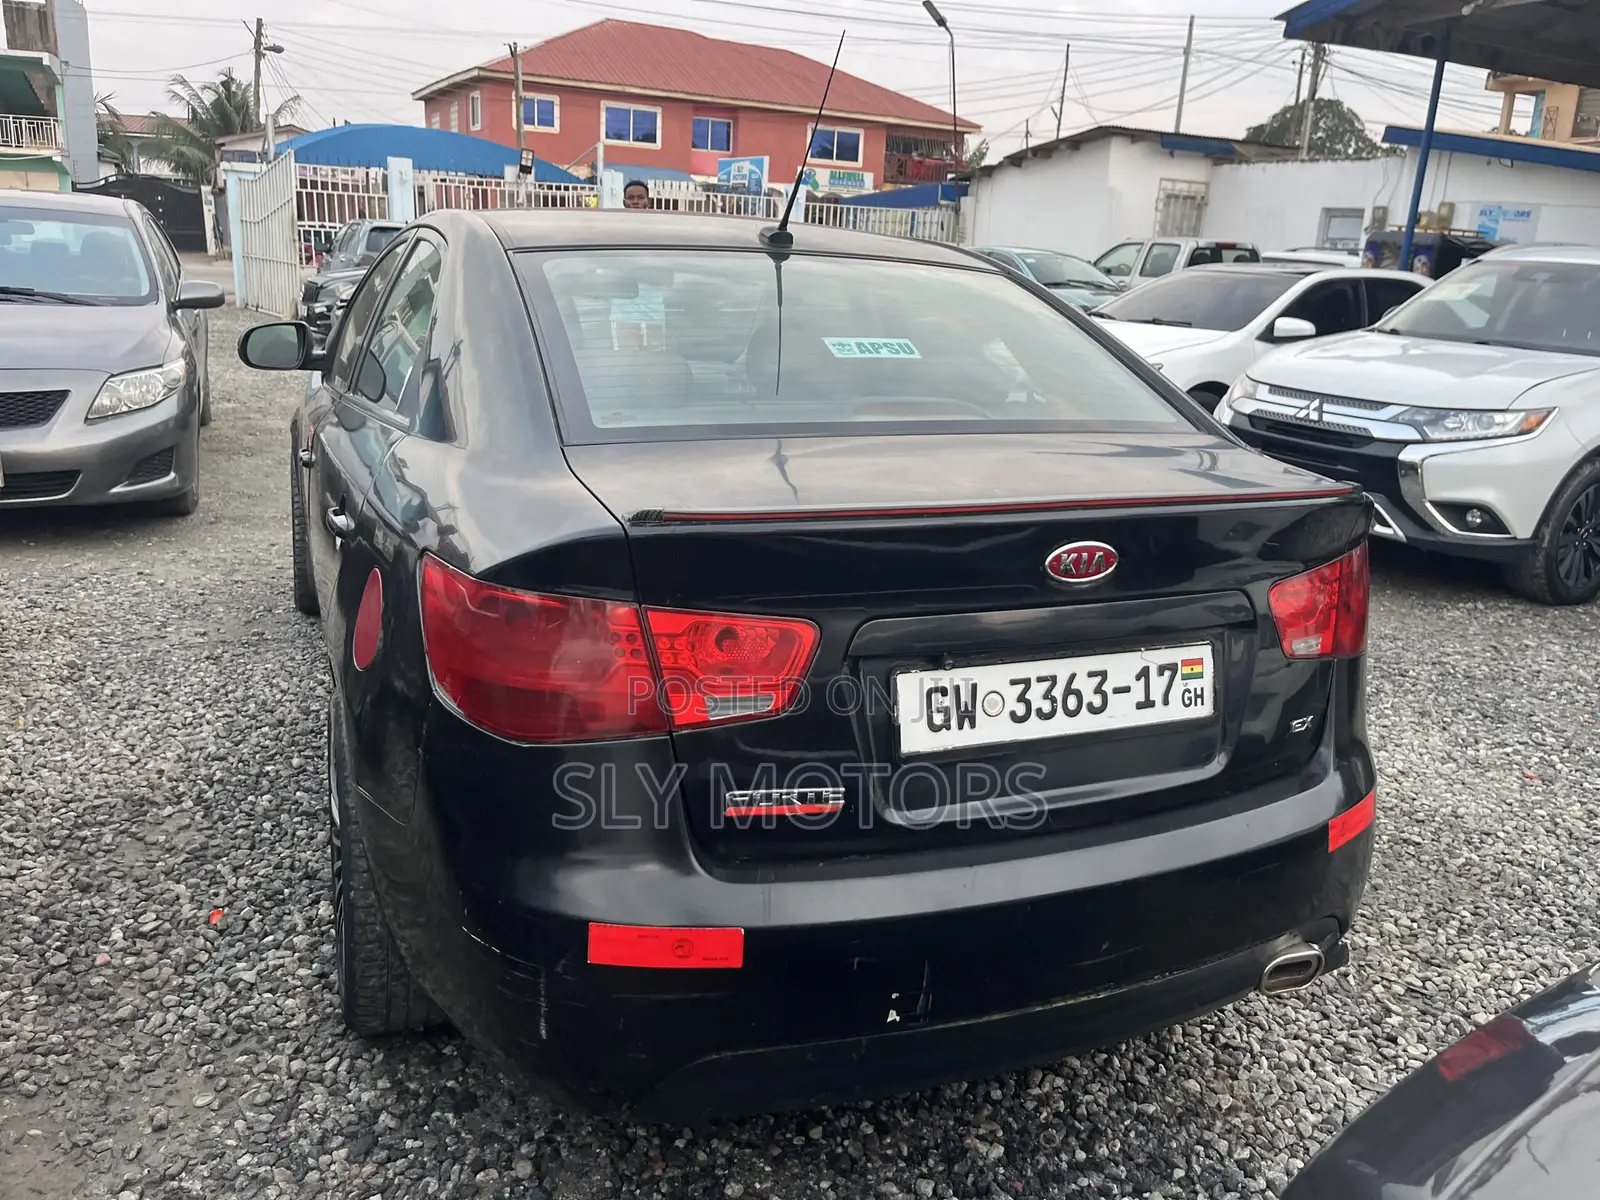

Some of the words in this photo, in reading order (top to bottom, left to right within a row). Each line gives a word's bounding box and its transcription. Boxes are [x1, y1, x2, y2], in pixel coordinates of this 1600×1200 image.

[854, 341, 915, 355] APSU
[1060, 551, 1106, 576] KIA
[926, 682, 977, 732] GW
[1009, 662, 1179, 724] 3363-17
[1181, 687, 1205, 708] GH
